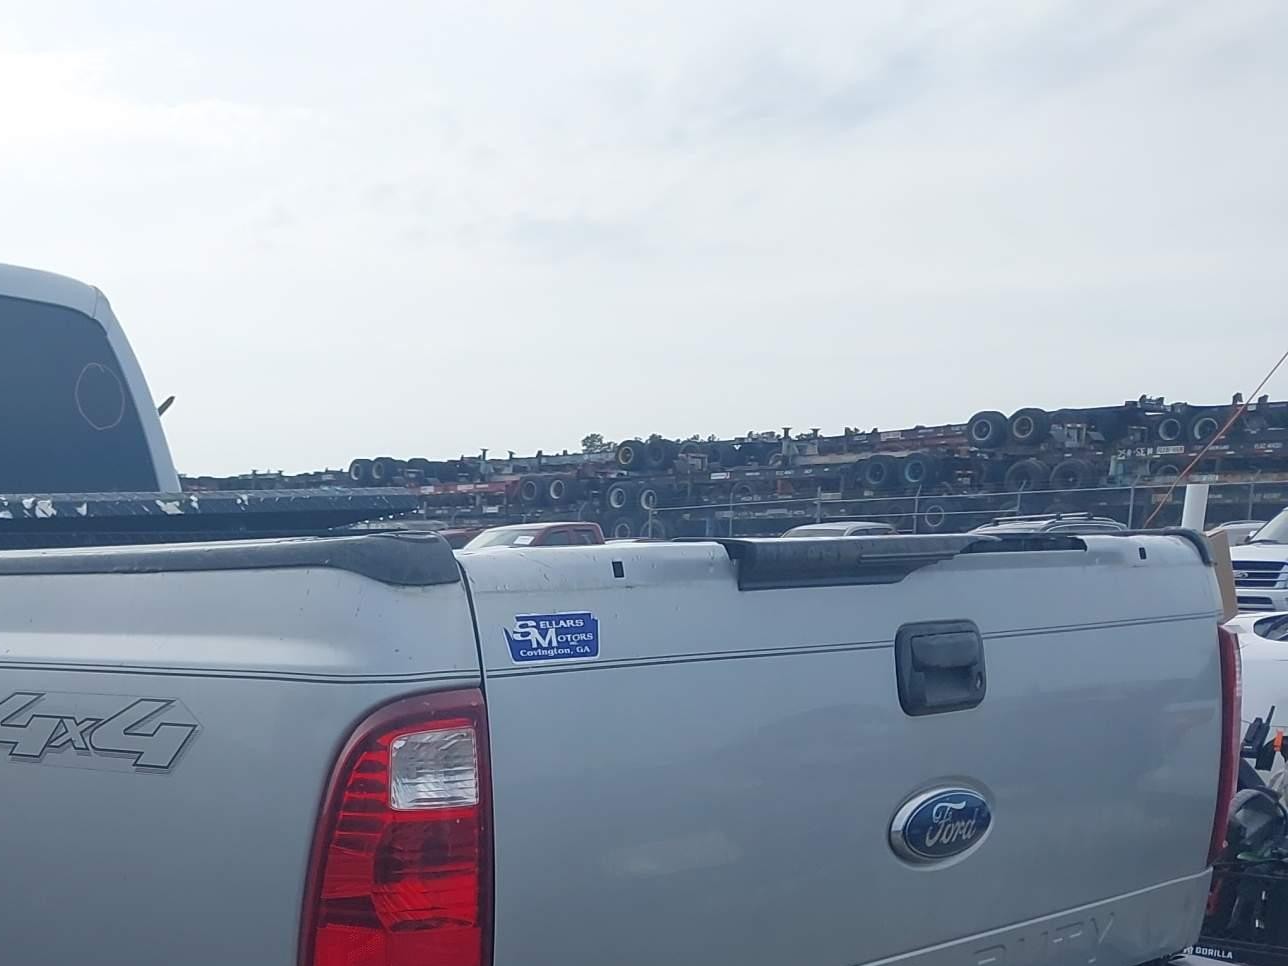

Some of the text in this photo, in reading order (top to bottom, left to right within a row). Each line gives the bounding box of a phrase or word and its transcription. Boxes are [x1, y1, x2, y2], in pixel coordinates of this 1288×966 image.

[513, 619, 584, 640] SELLARS
[531, 628, 593, 648] MOTORS
[520, 645, 590, 657] Covington, GA
[925, 800, 980, 847] Ford
[1195, 946, 1233, 959] GORILLA
